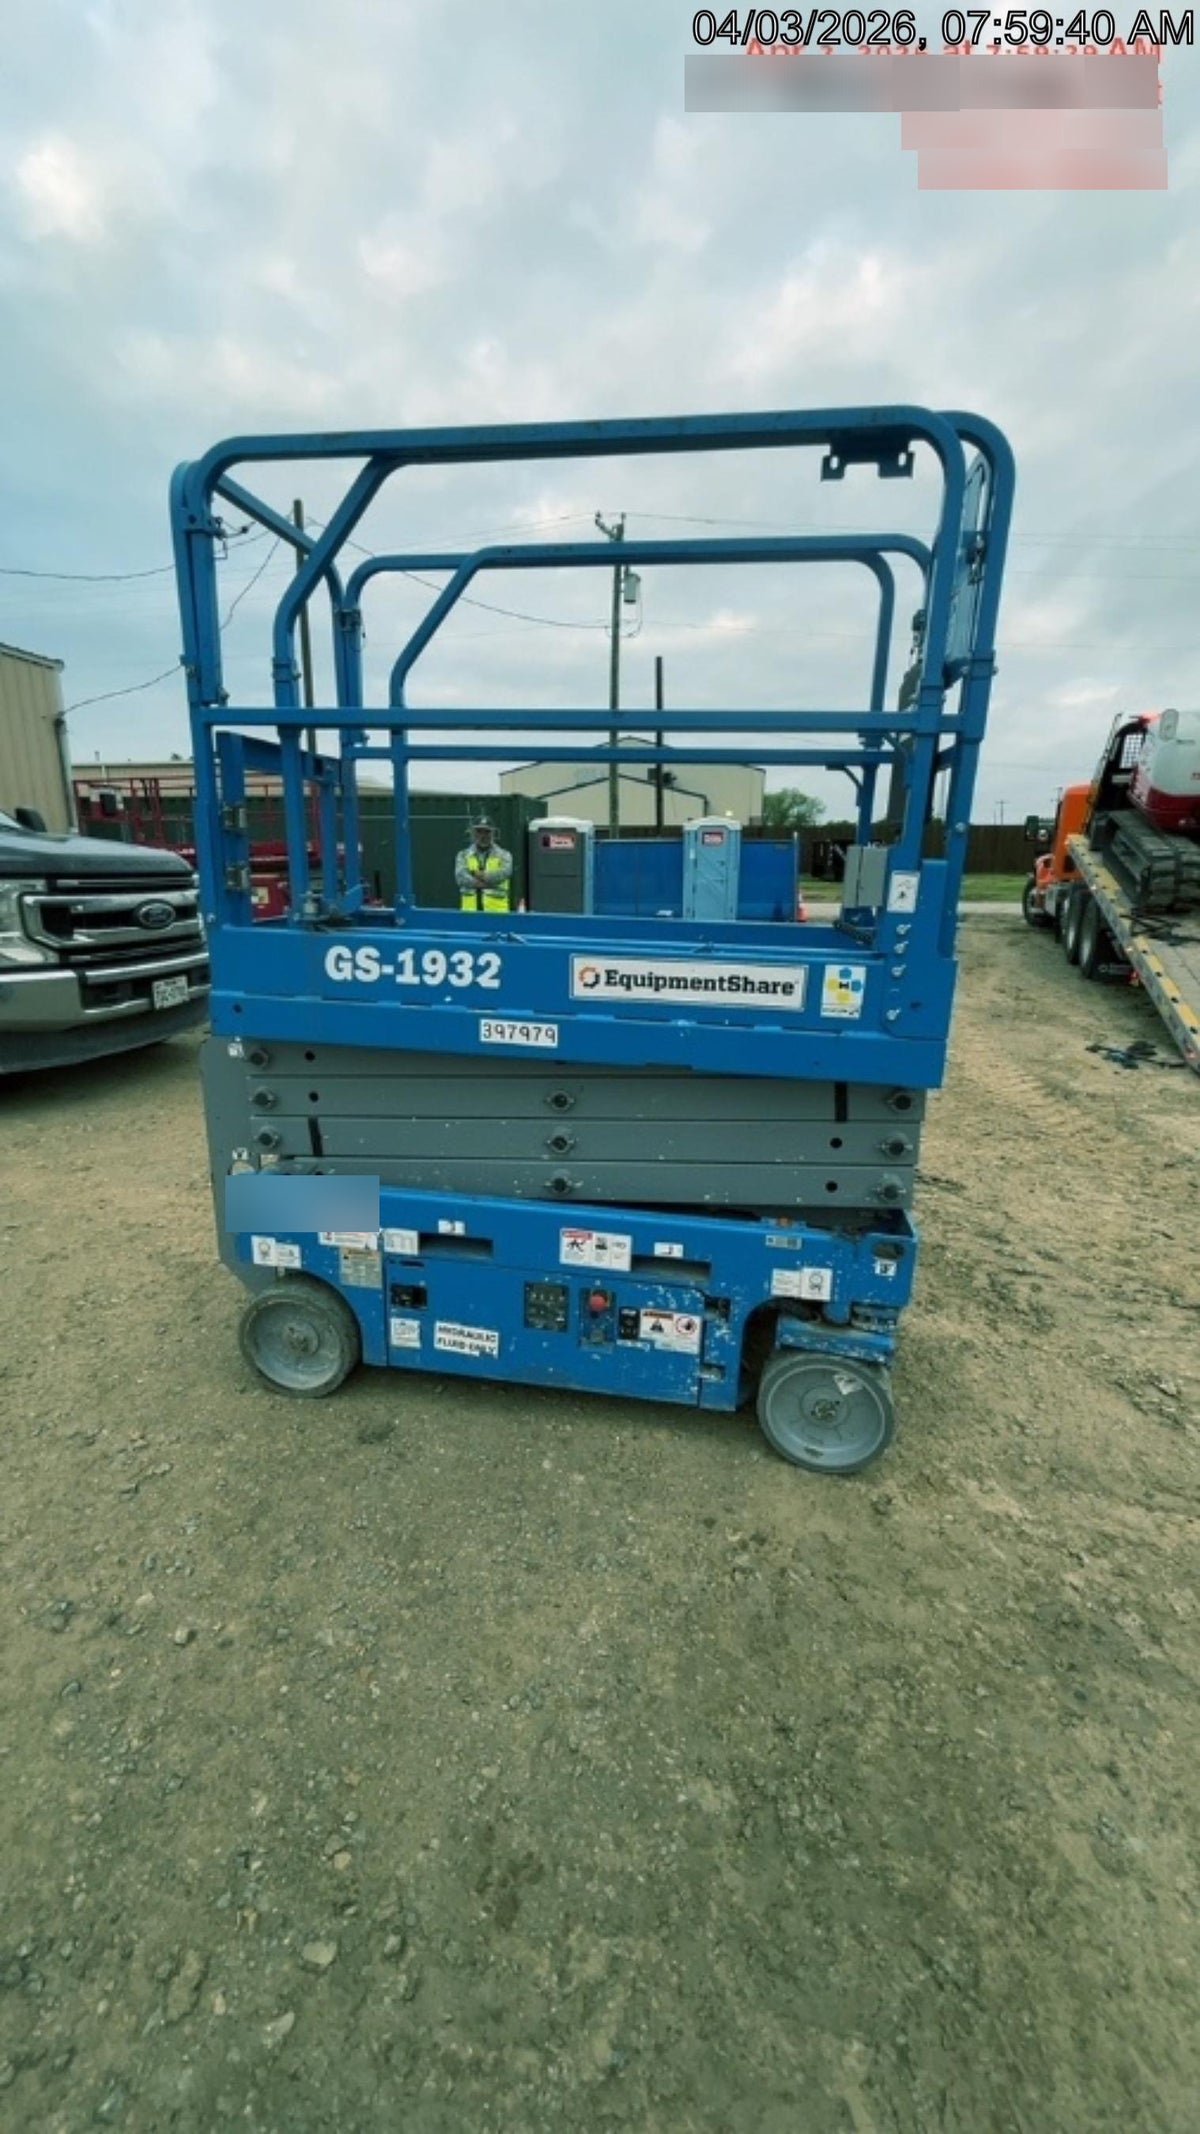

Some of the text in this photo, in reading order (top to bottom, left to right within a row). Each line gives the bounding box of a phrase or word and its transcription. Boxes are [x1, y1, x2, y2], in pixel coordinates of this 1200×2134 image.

[324, 945, 501, 990] GS-1932
[604, 969, 795, 996] EquipmentShare
[483, 1022, 556, 1044] 397979
